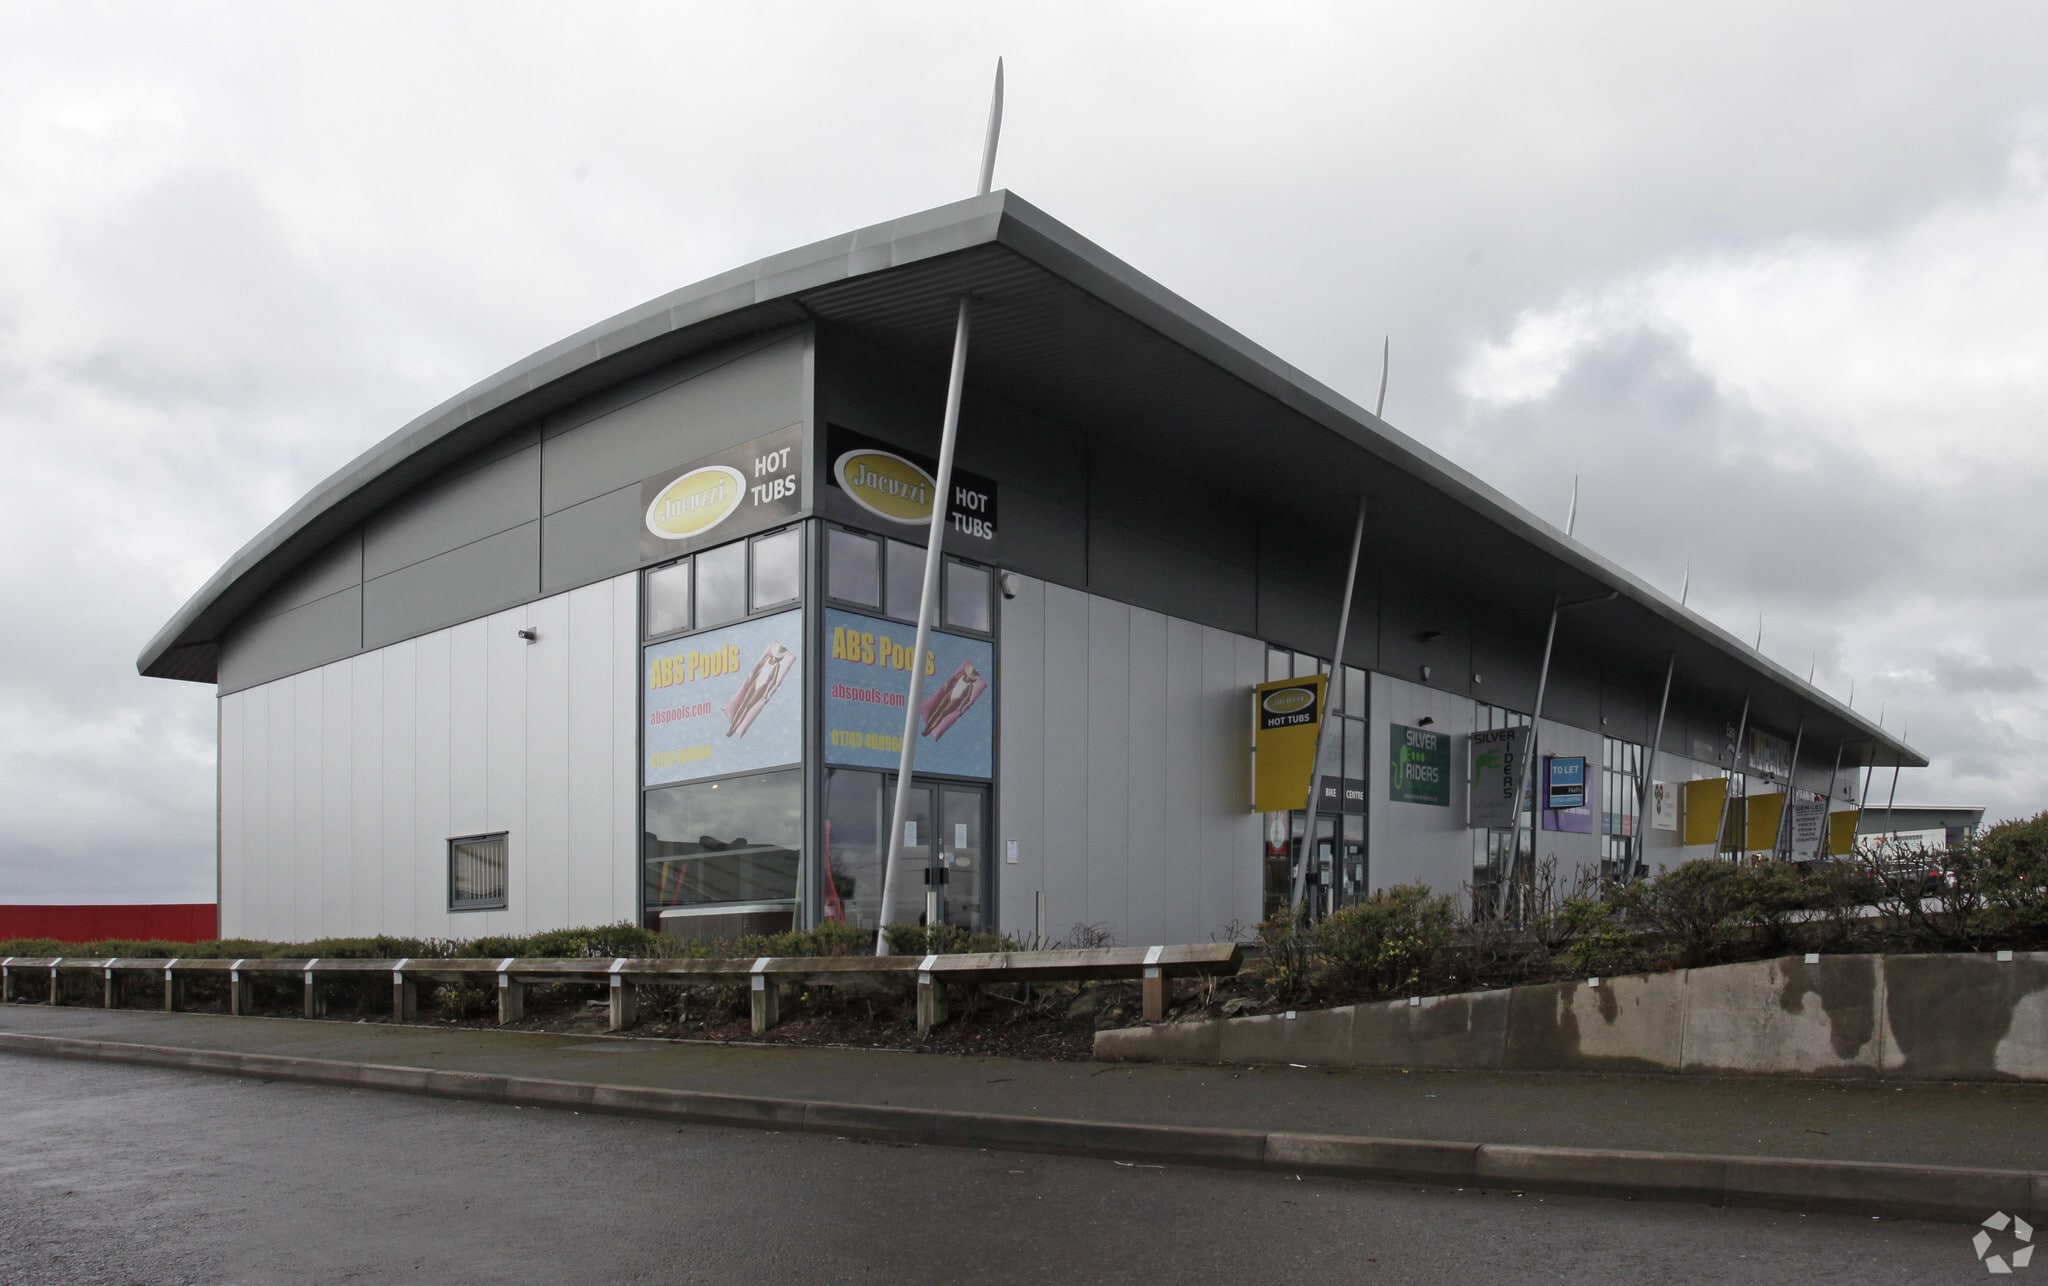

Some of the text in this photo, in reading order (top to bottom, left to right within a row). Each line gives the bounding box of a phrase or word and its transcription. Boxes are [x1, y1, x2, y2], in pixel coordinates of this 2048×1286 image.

[755, 447, 791, 477] HOT
[751, 475, 796, 506] TUBS
[853, 463, 925, 505] Jacuzzi
[659, 478, 726, 522] Jacuzzi
[955, 486, 988, 513] HOT
[952, 512, 992, 540] TUBS
[832, 627, 936, 676] ABS Poos
[651, 643, 740, 690] ABS Pools
[832, 684, 905, 707] abspools.com
[650, 702, 711, 726] abspools.com
[1268, 713, 1310, 727] HOT TUBS
[1406, 730, 1437, 751] SILVER
[1474, 730, 1515, 745] SILVER
[1406, 763, 1439, 783] RIDERS
[1553, 765, 1579, 774] TO LET
[1325, 788, 1363, 800] BIKE CENTRE
